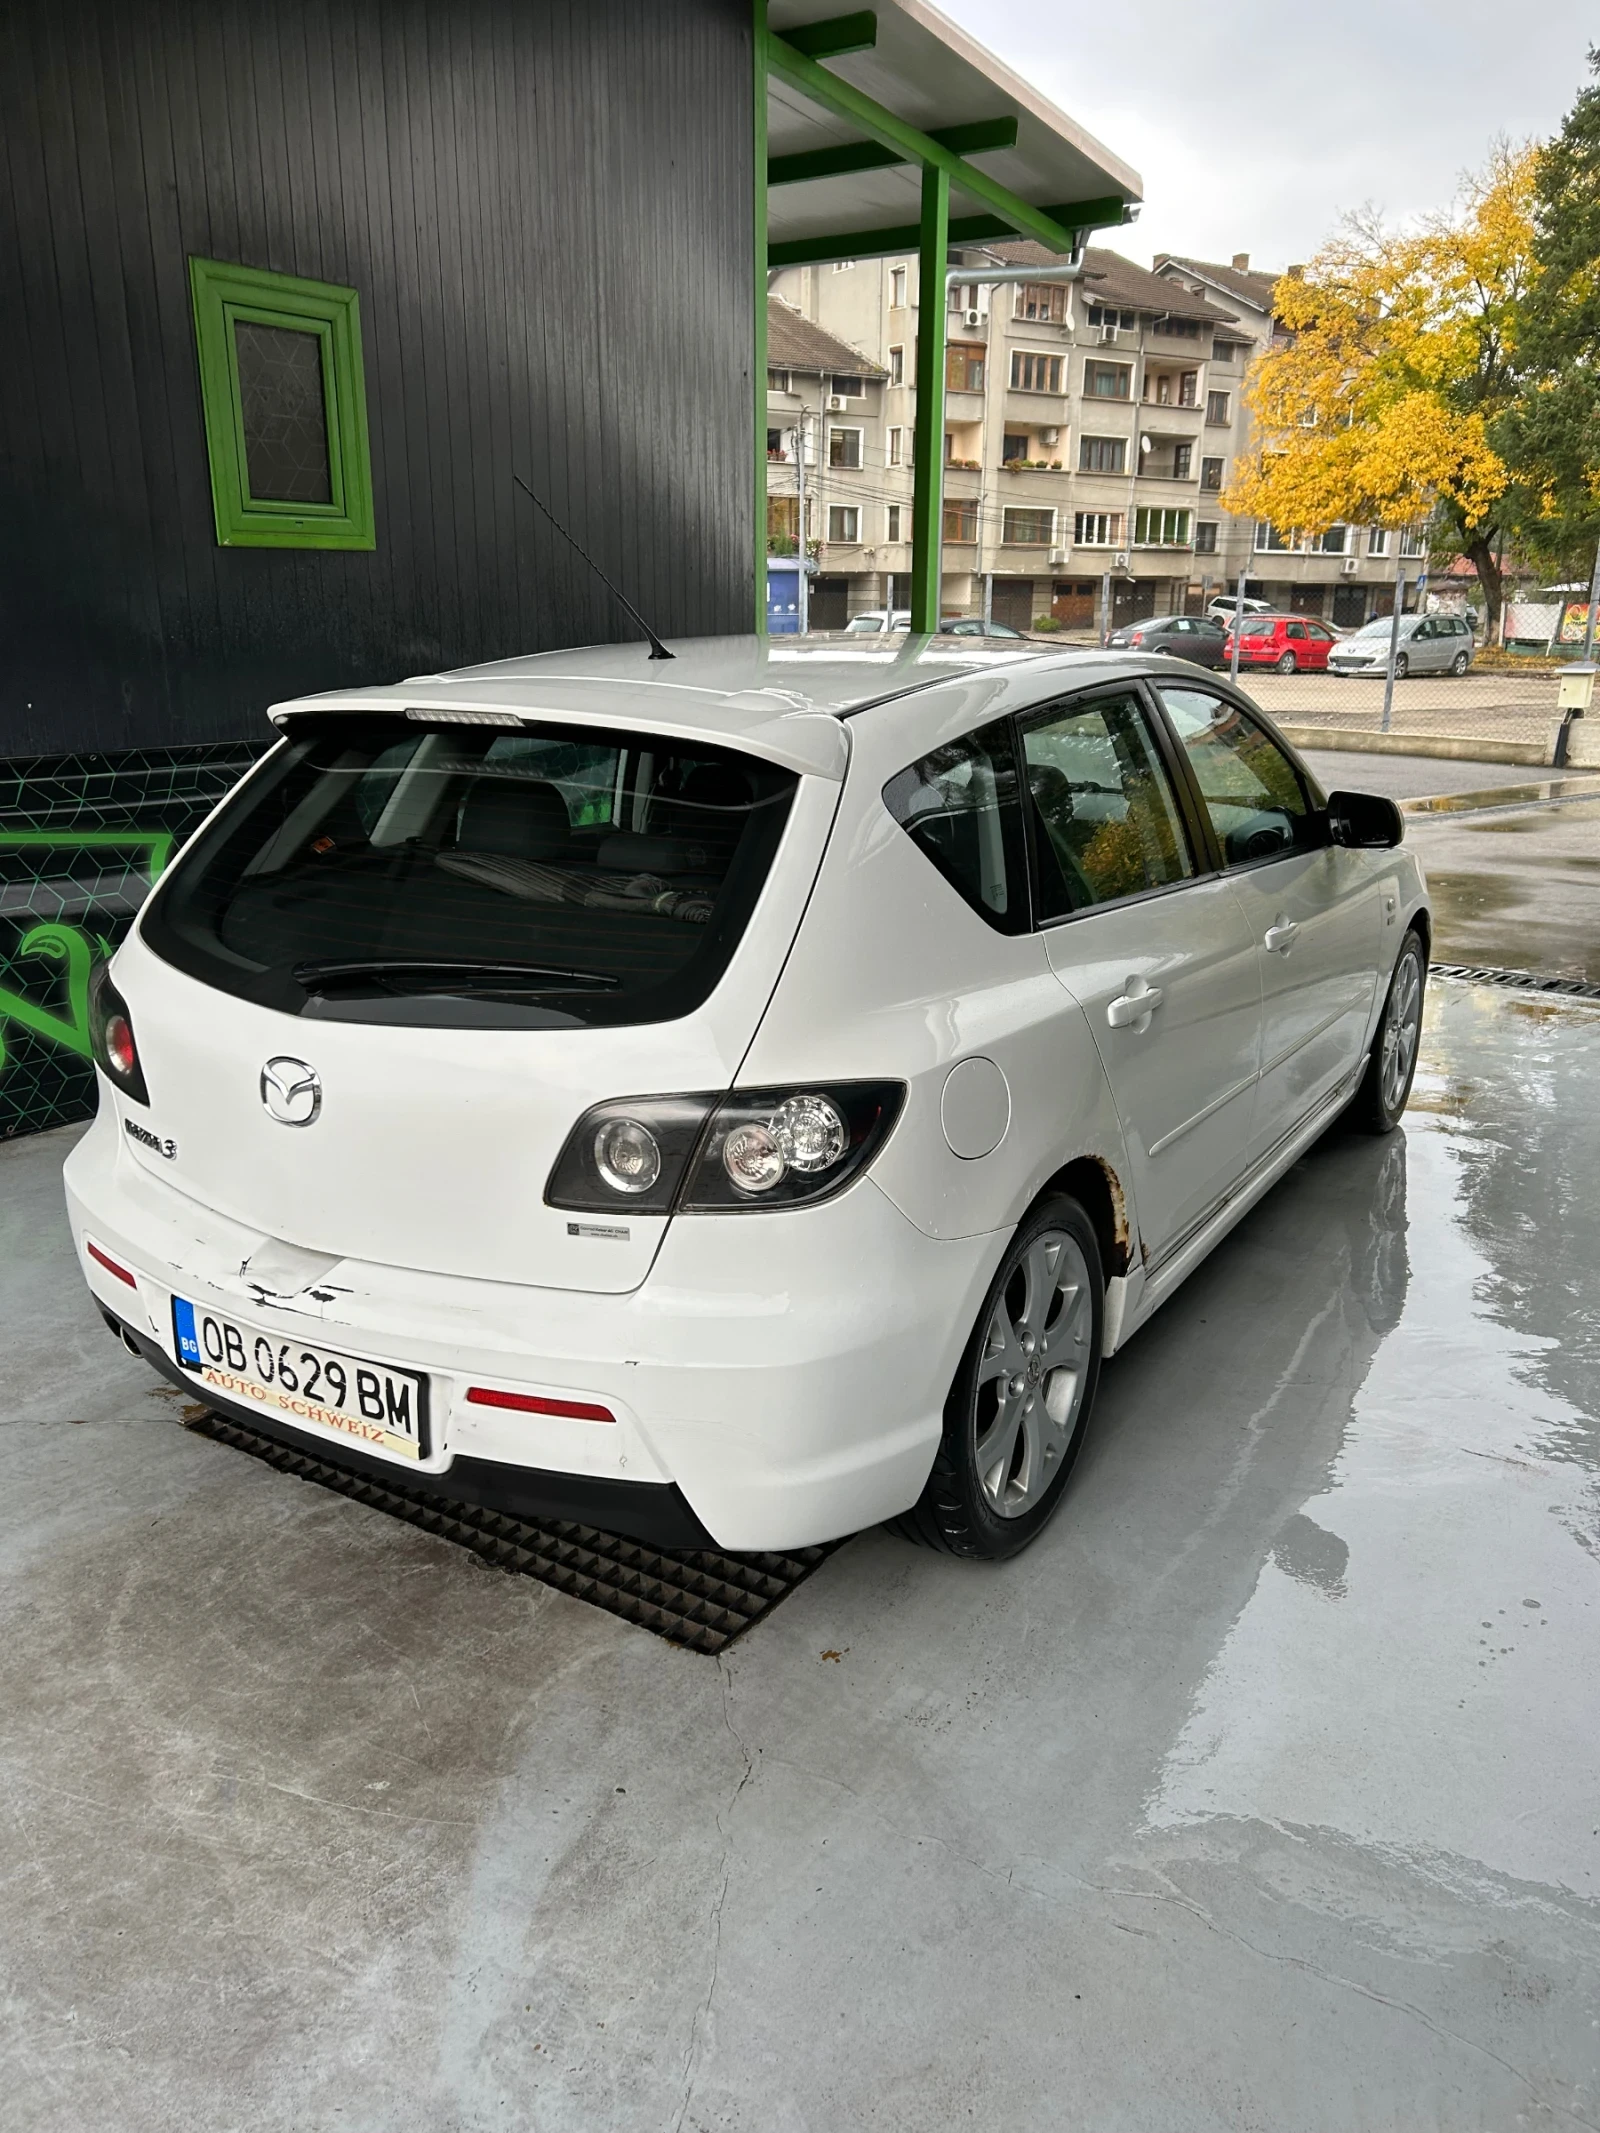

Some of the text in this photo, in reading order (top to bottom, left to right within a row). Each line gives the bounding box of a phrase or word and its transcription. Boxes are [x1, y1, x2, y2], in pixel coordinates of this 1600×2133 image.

[181, 1336, 198, 1353] BG
[203, 1316, 412, 1435] OB 0629 BM
[205, 1370, 385, 1444] AUTO SCHWEIZ
